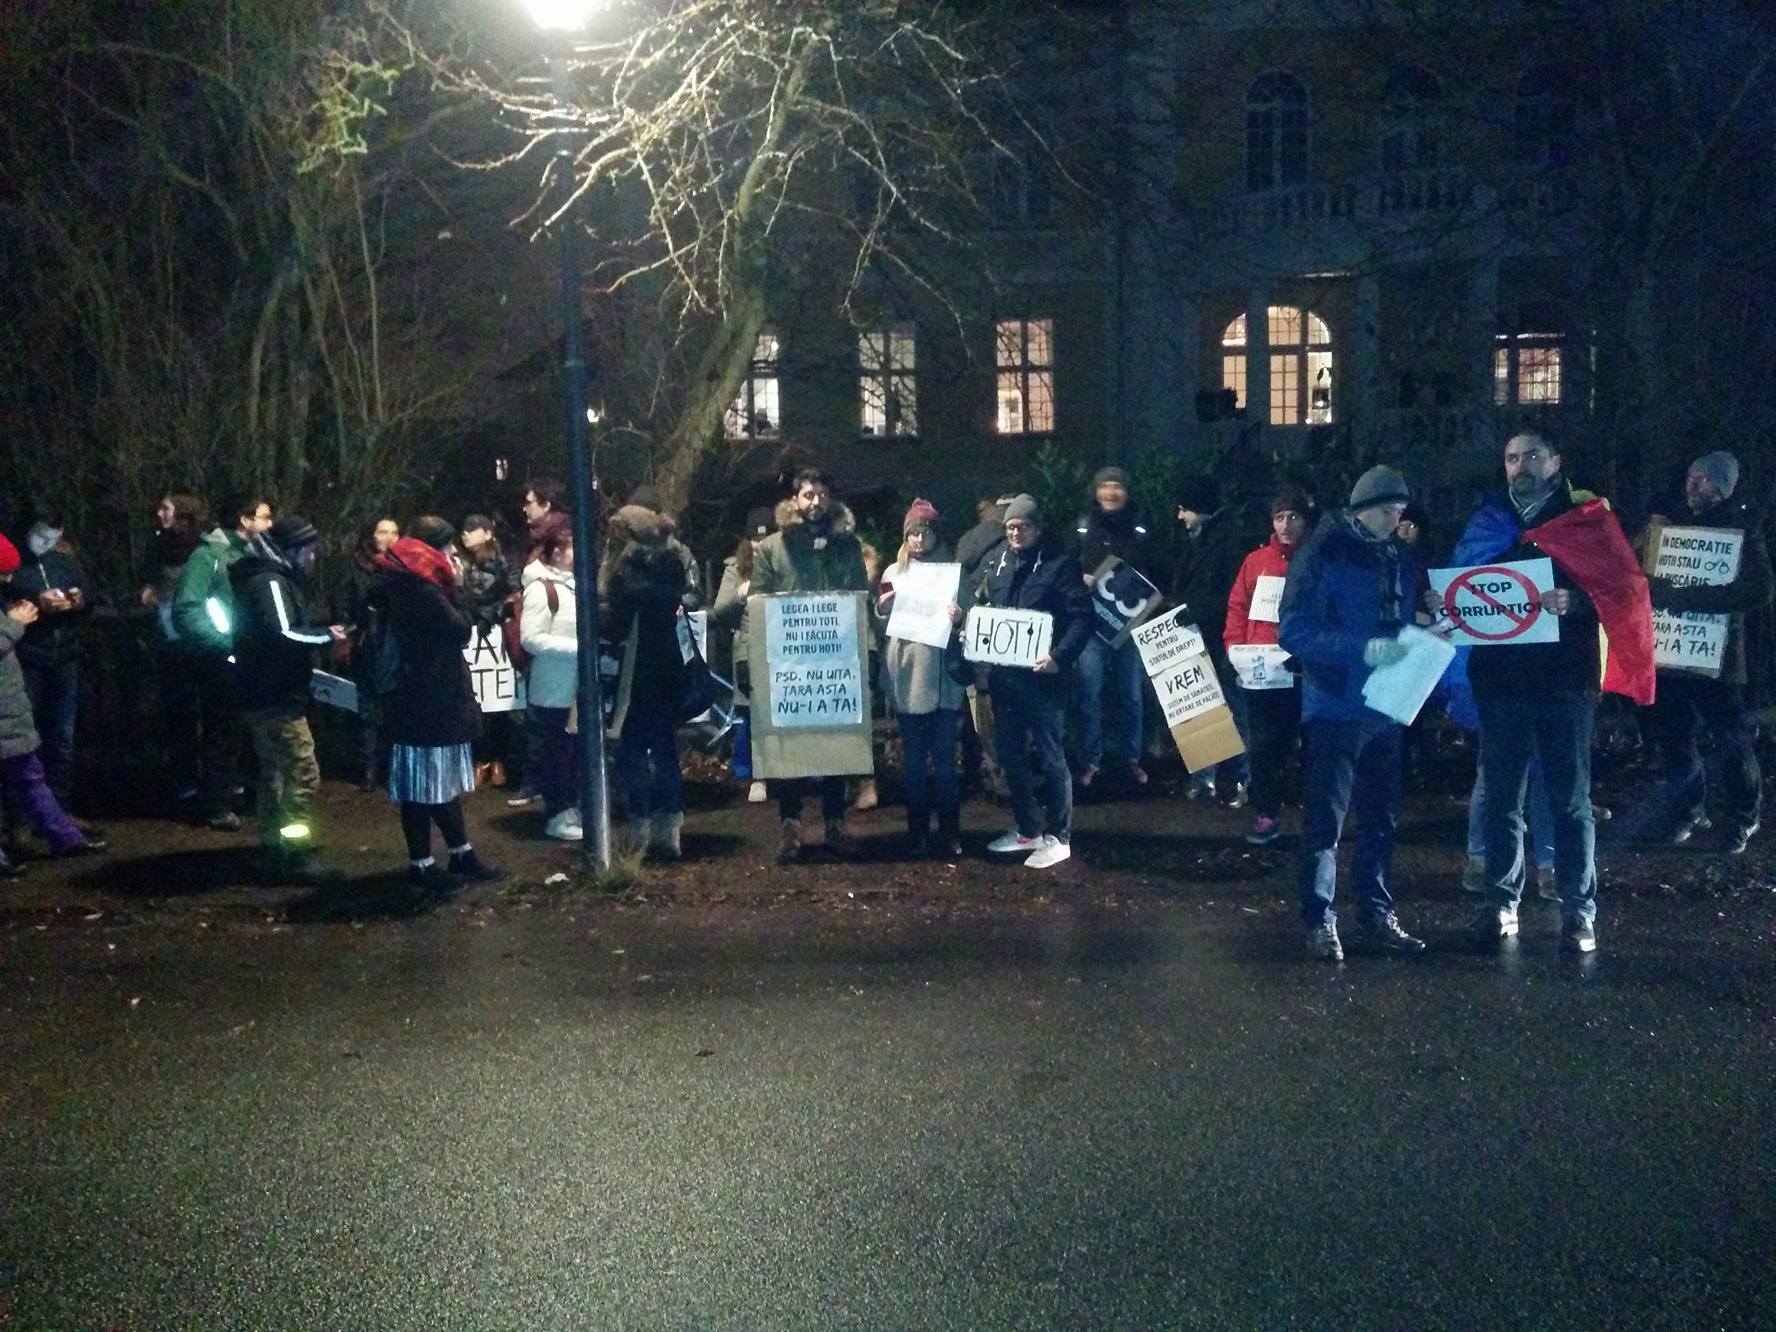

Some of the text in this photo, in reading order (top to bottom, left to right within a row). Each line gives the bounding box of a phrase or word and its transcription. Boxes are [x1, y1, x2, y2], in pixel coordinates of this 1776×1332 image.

[1677, 556, 1701, 570] STAU
[782, 604, 808, 614] LEGEA
[817, 602, 839, 613] LEGE
[782, 618, 817, 628] PENTRU
[785, 631, 798, 641] NU
[1673, 625, 1708, 638] ASTA
[782, 644, 817, 655] PENTRU
[1671, 639, 1682, 654] A
[1688, 640, 1716, 657] TA!
[806, 670, 823, 681] NU
[1165, 664, 1205, 695] VREM
[817, 683, 847, 696] ASTA
[817, 699, 828, 714] A
[832, 698, 857, 713] TA!
